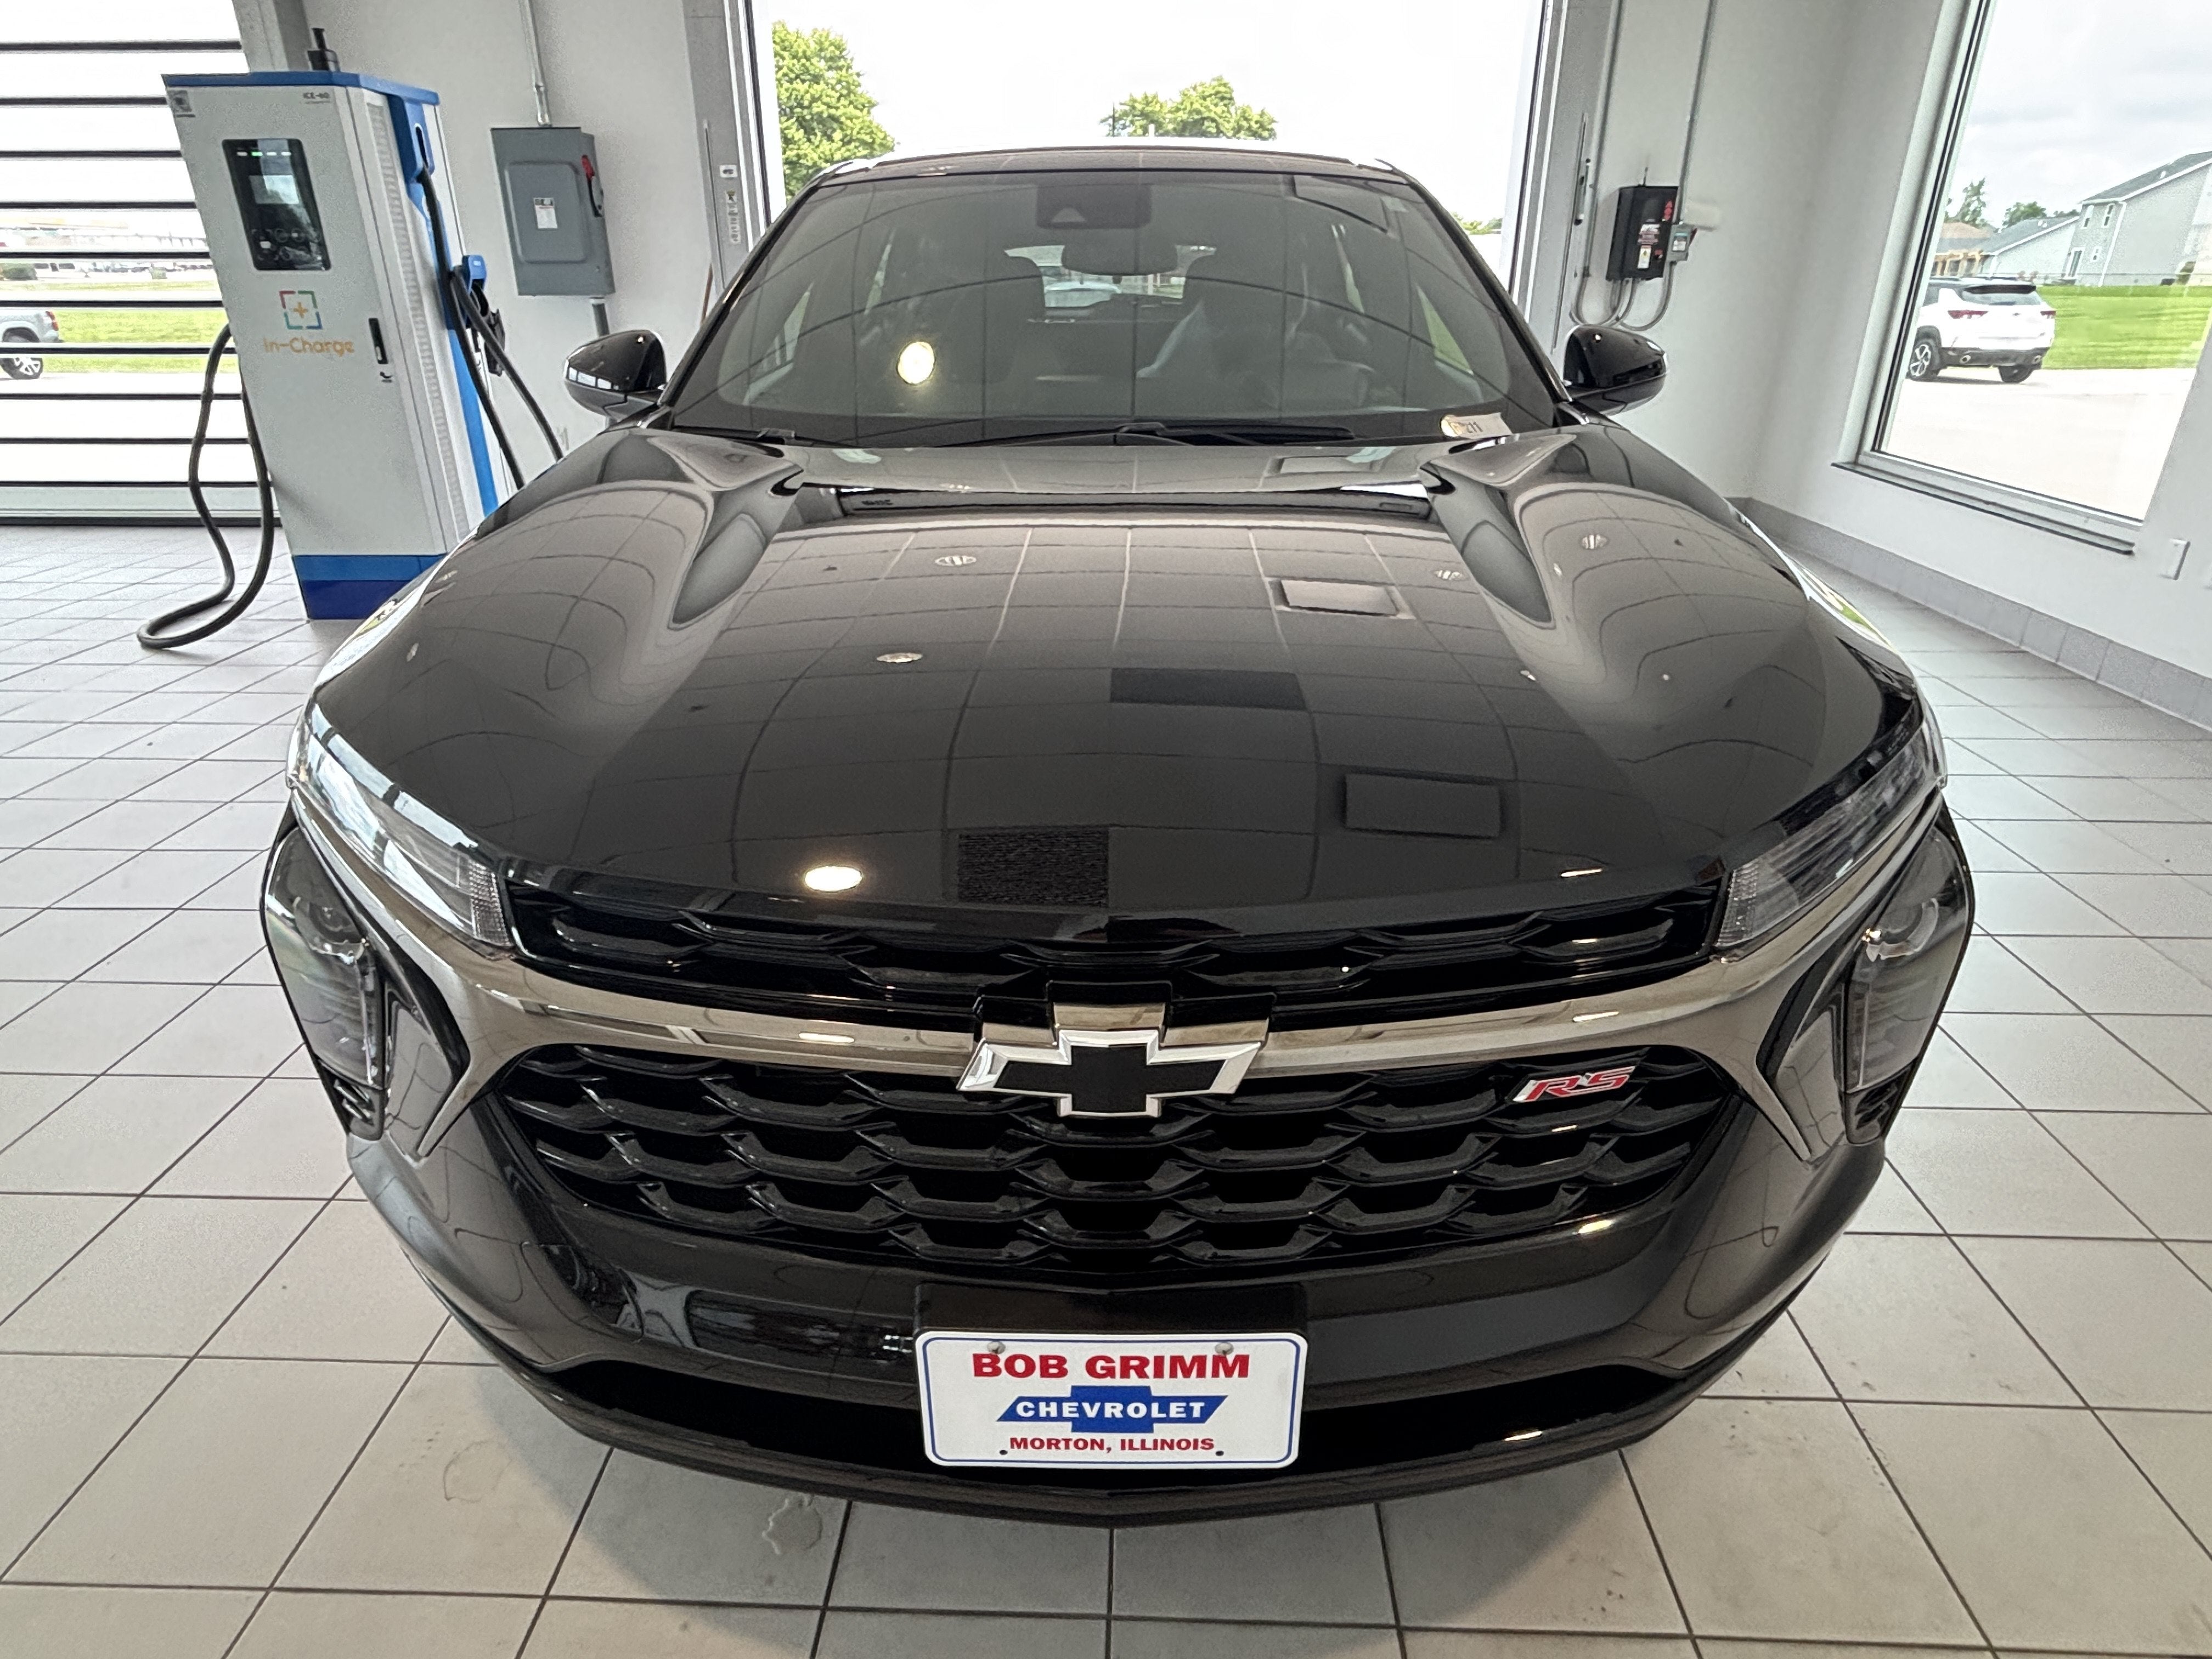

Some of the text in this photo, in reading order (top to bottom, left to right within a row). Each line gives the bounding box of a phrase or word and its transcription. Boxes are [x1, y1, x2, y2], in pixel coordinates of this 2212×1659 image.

[263, 337, 354, 357] In-Charge
[1513, 1066, 1636, 1102] RS
[972, 1353, 1250, 1379] BOB GRIMM
[1015, 1401, 1205, 1419] CHEVROLET
[1009, 1437, 1215, 1454] MORTON, ILLINOIS
